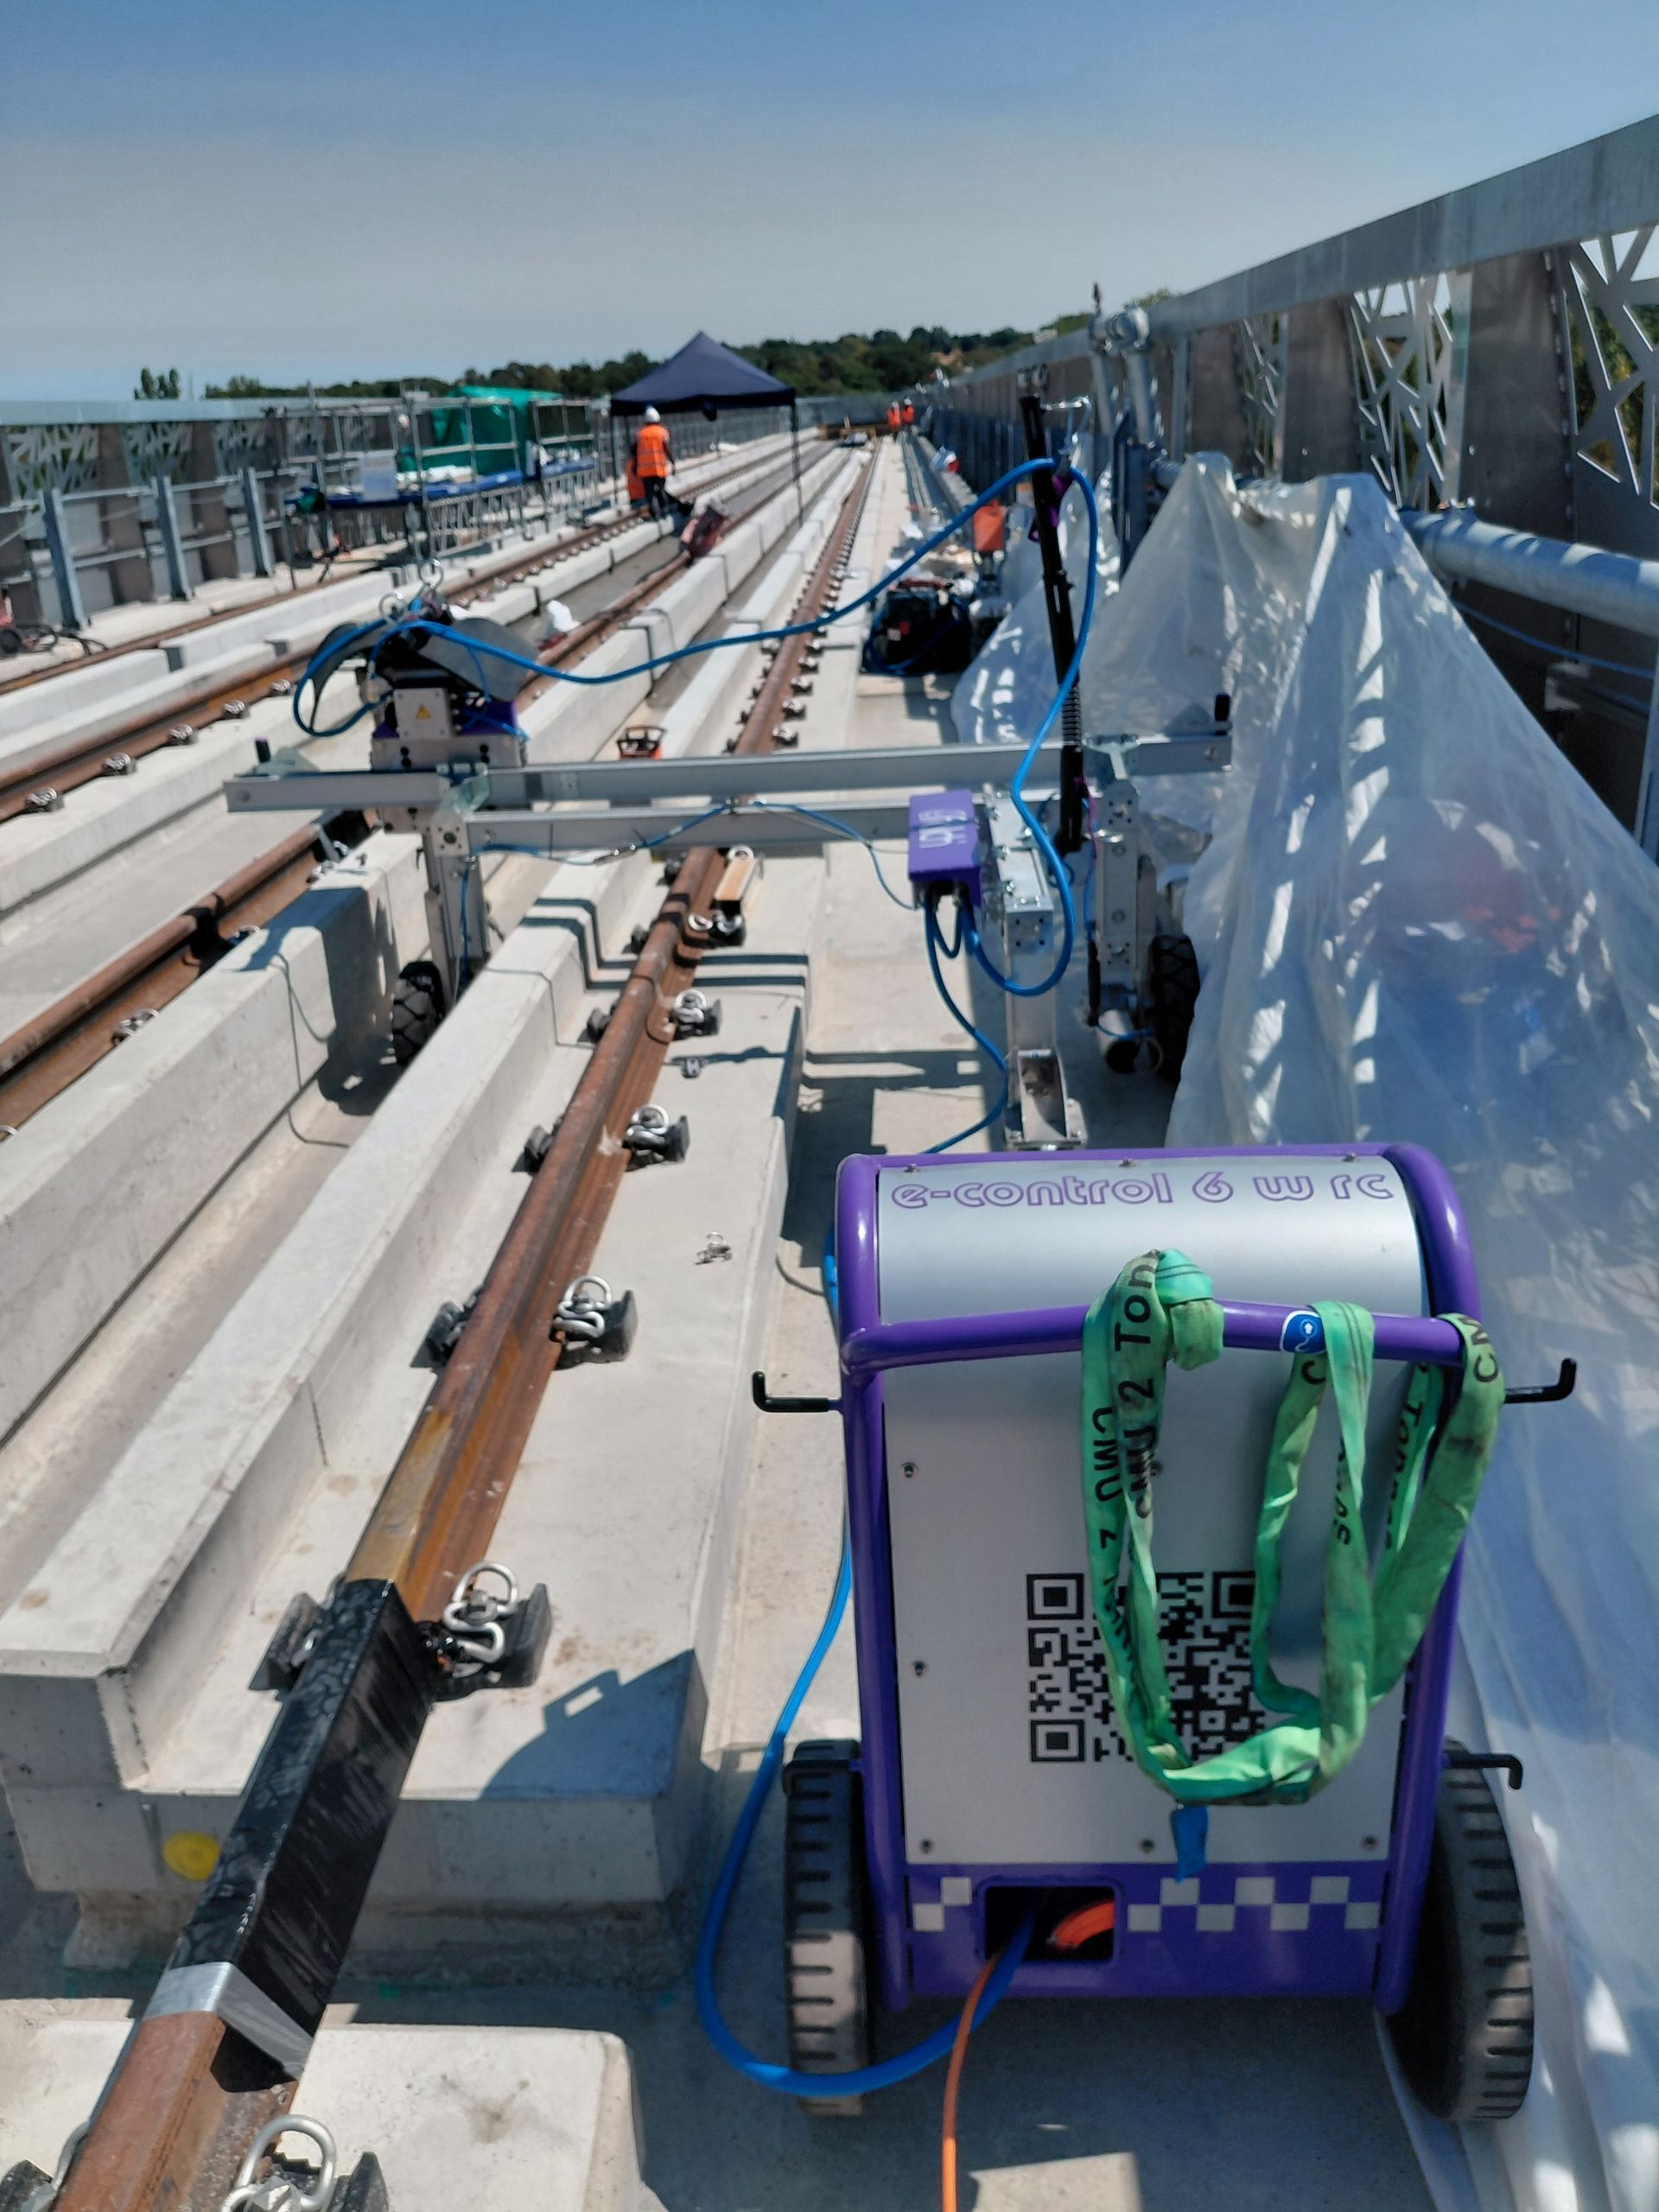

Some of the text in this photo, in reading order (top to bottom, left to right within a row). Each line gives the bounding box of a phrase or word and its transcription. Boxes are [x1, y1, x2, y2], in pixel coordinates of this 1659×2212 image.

[891, 1172, 1395, 1209] e-control 6 w rc
[1118, 1378, 1154, 1402] 2
[1092, 1407, 1123, 1502] CMU
